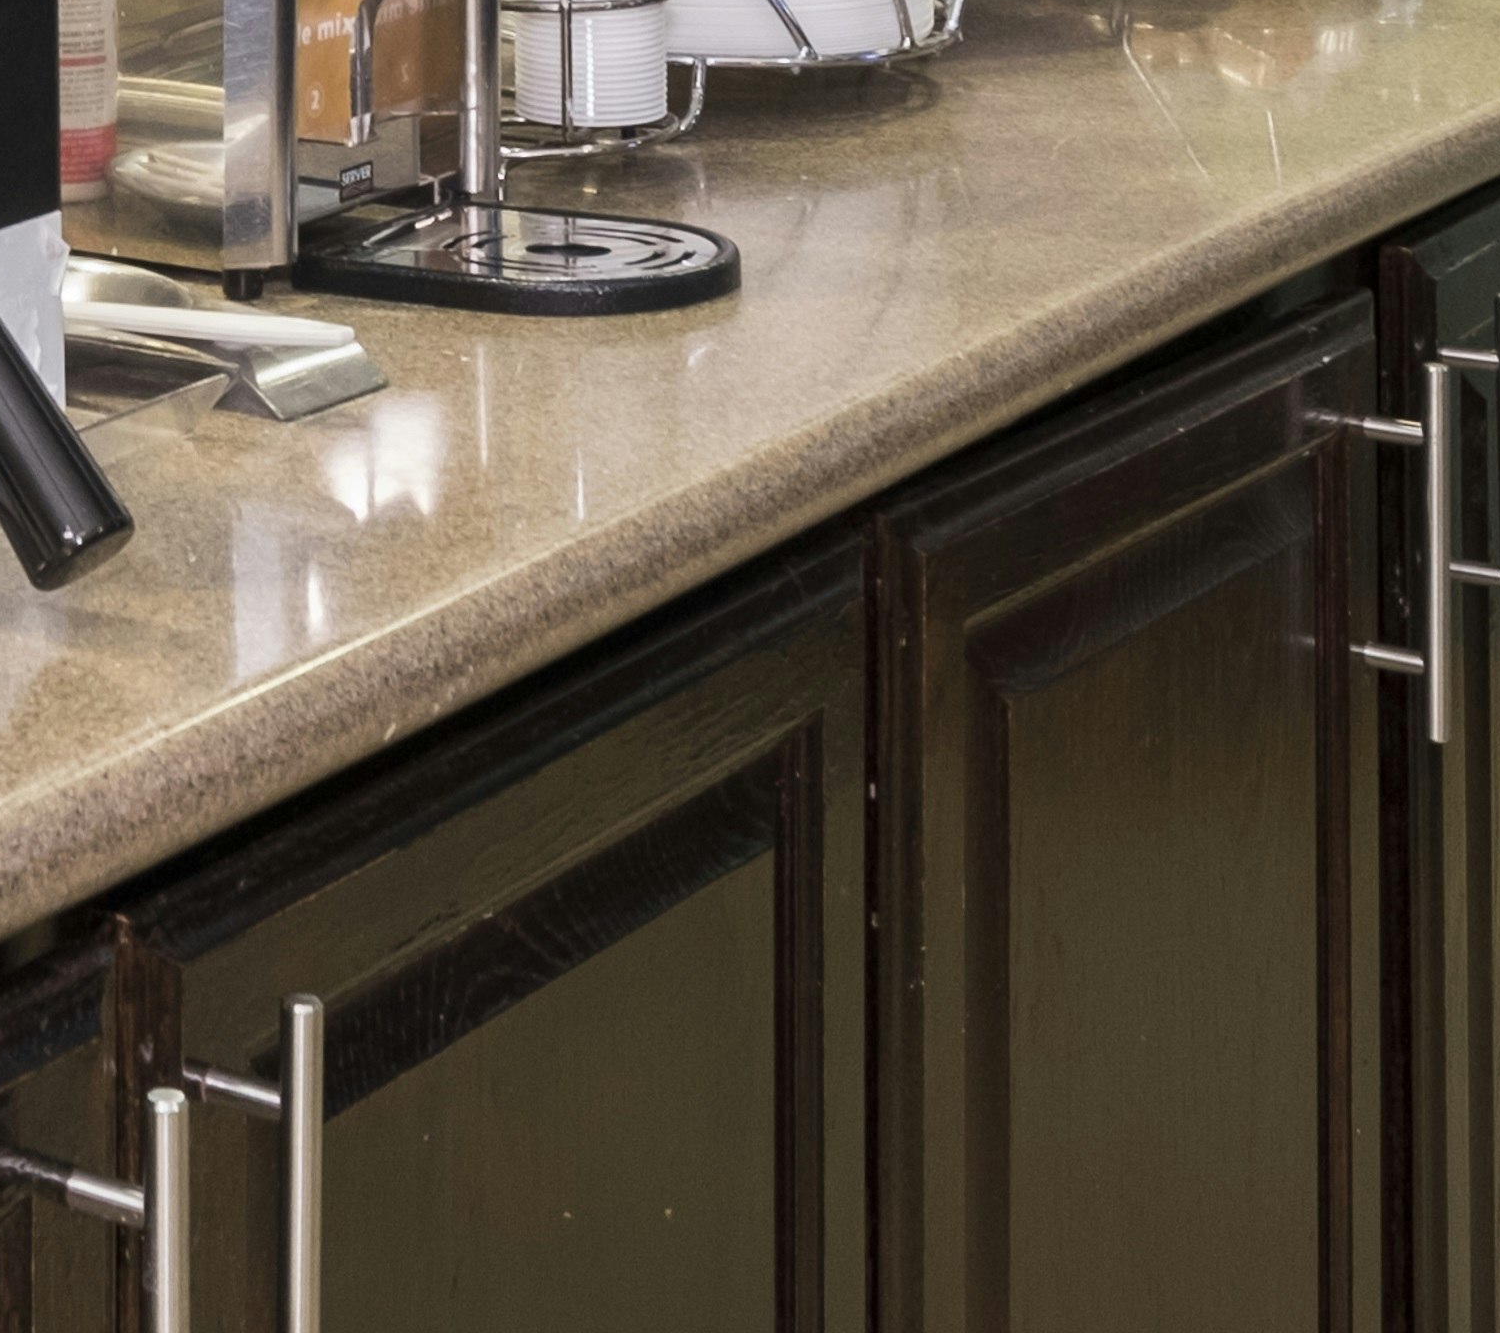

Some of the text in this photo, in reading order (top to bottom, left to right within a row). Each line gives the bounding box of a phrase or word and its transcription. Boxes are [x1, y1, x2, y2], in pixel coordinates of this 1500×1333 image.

[317, 13, 356, 42] mix
[310, 90, 320, 111] 2
[342, 165, 371, 187] SERVER
